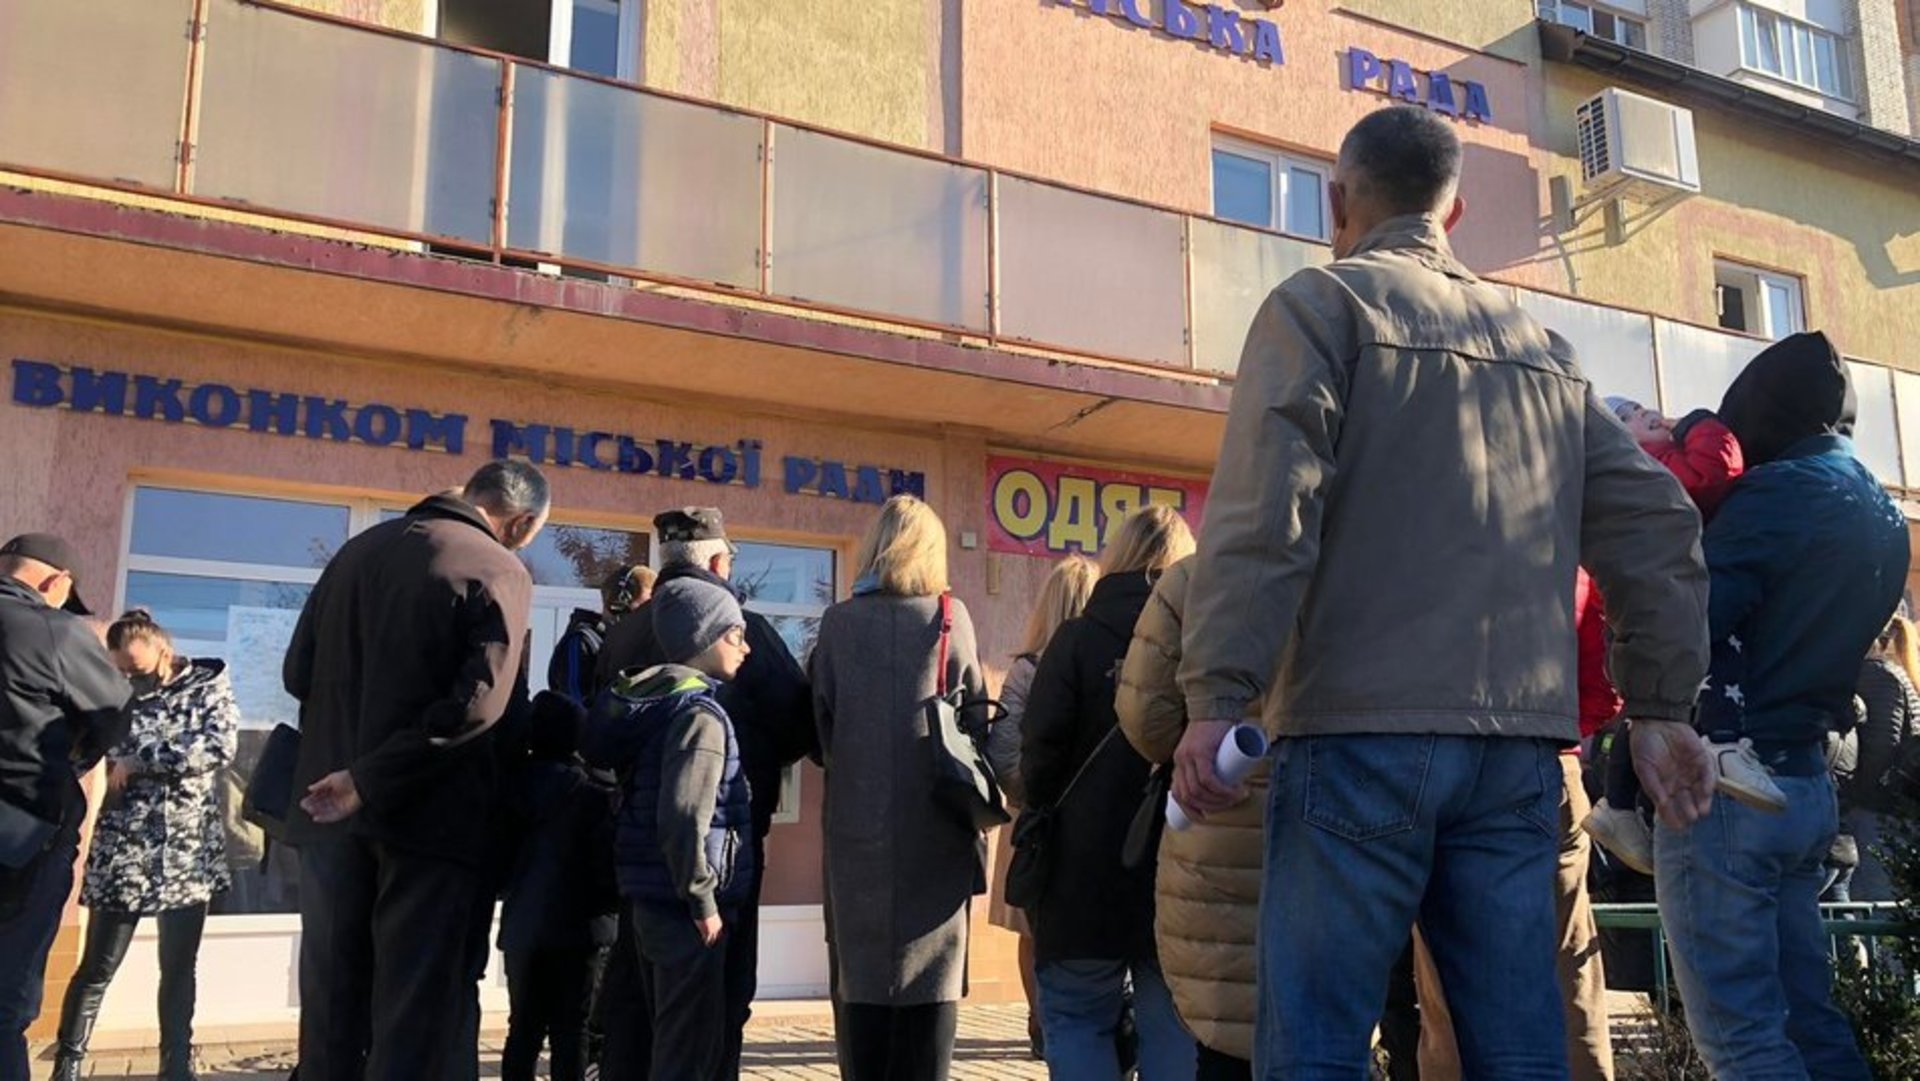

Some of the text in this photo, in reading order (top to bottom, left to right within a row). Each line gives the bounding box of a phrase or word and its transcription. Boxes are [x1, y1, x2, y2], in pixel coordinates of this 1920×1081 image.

[1046, 0, 1493, 124] СЬКА РАДА
[12, 359, 925, 506] ВИКОНКОМ МІСЬКОЇ РАДИ
